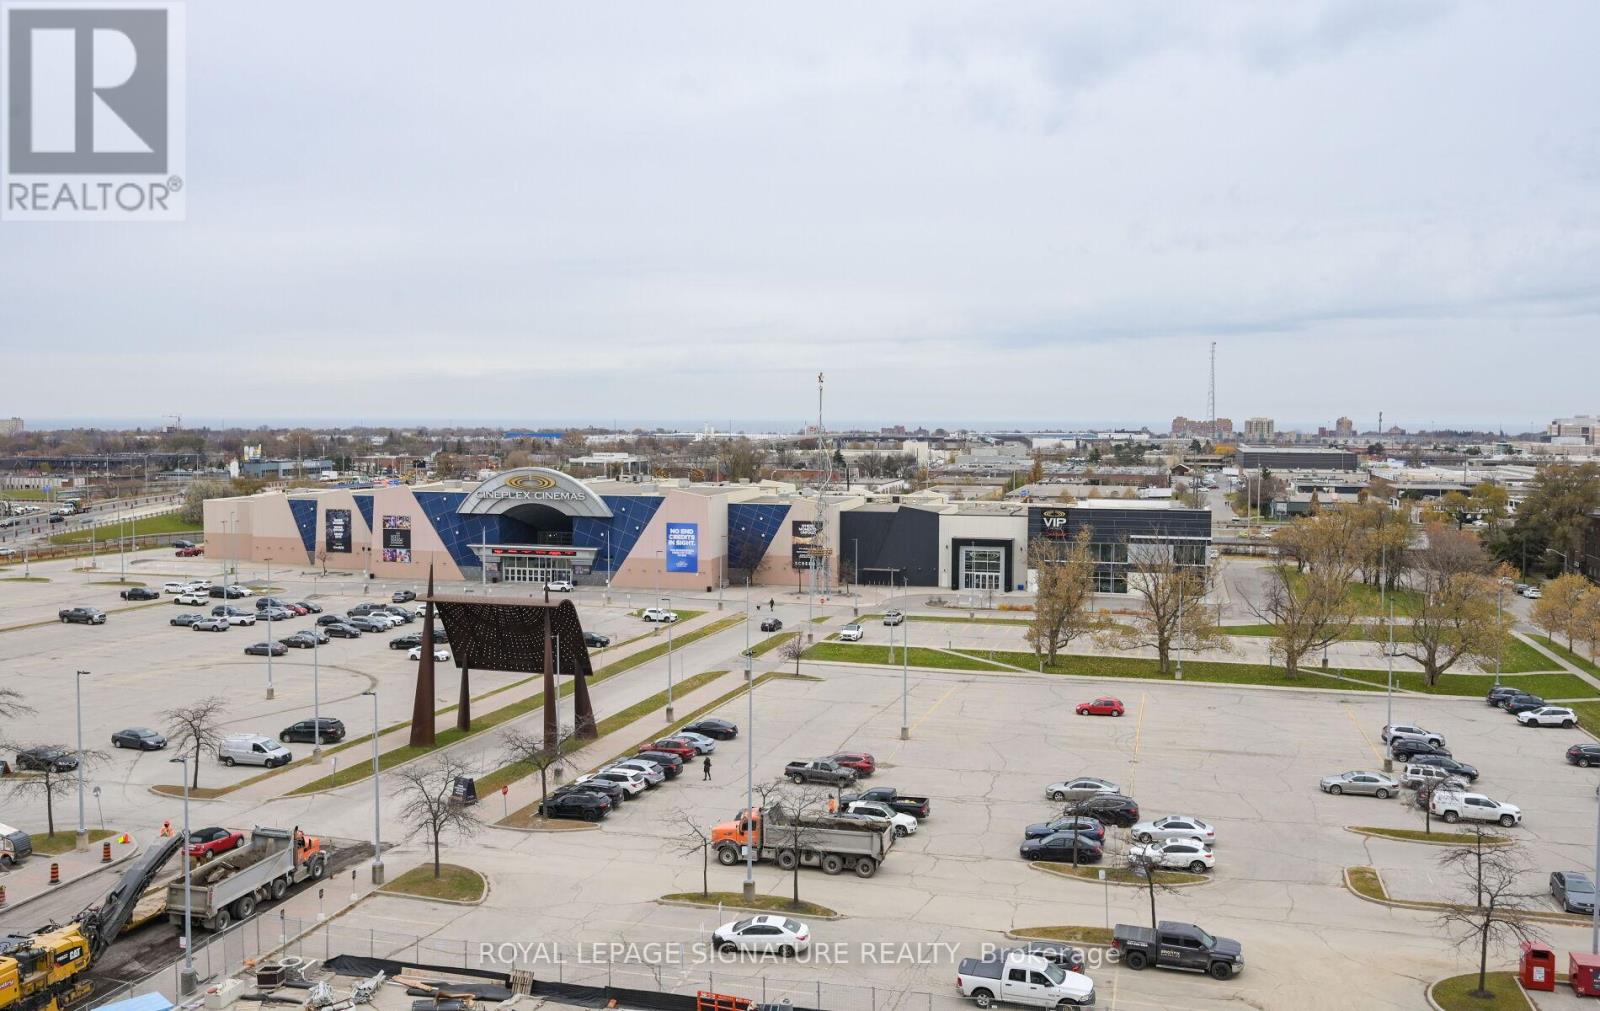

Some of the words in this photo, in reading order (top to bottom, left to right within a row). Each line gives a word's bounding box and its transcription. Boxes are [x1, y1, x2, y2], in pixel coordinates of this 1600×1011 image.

[475, 491, 531, 500] CINEPLEX
[534, 491, 586, 501] CINEMAS
[1043, 517, 1067, 528] VIP
[69, 947, 81, 961] CAT
